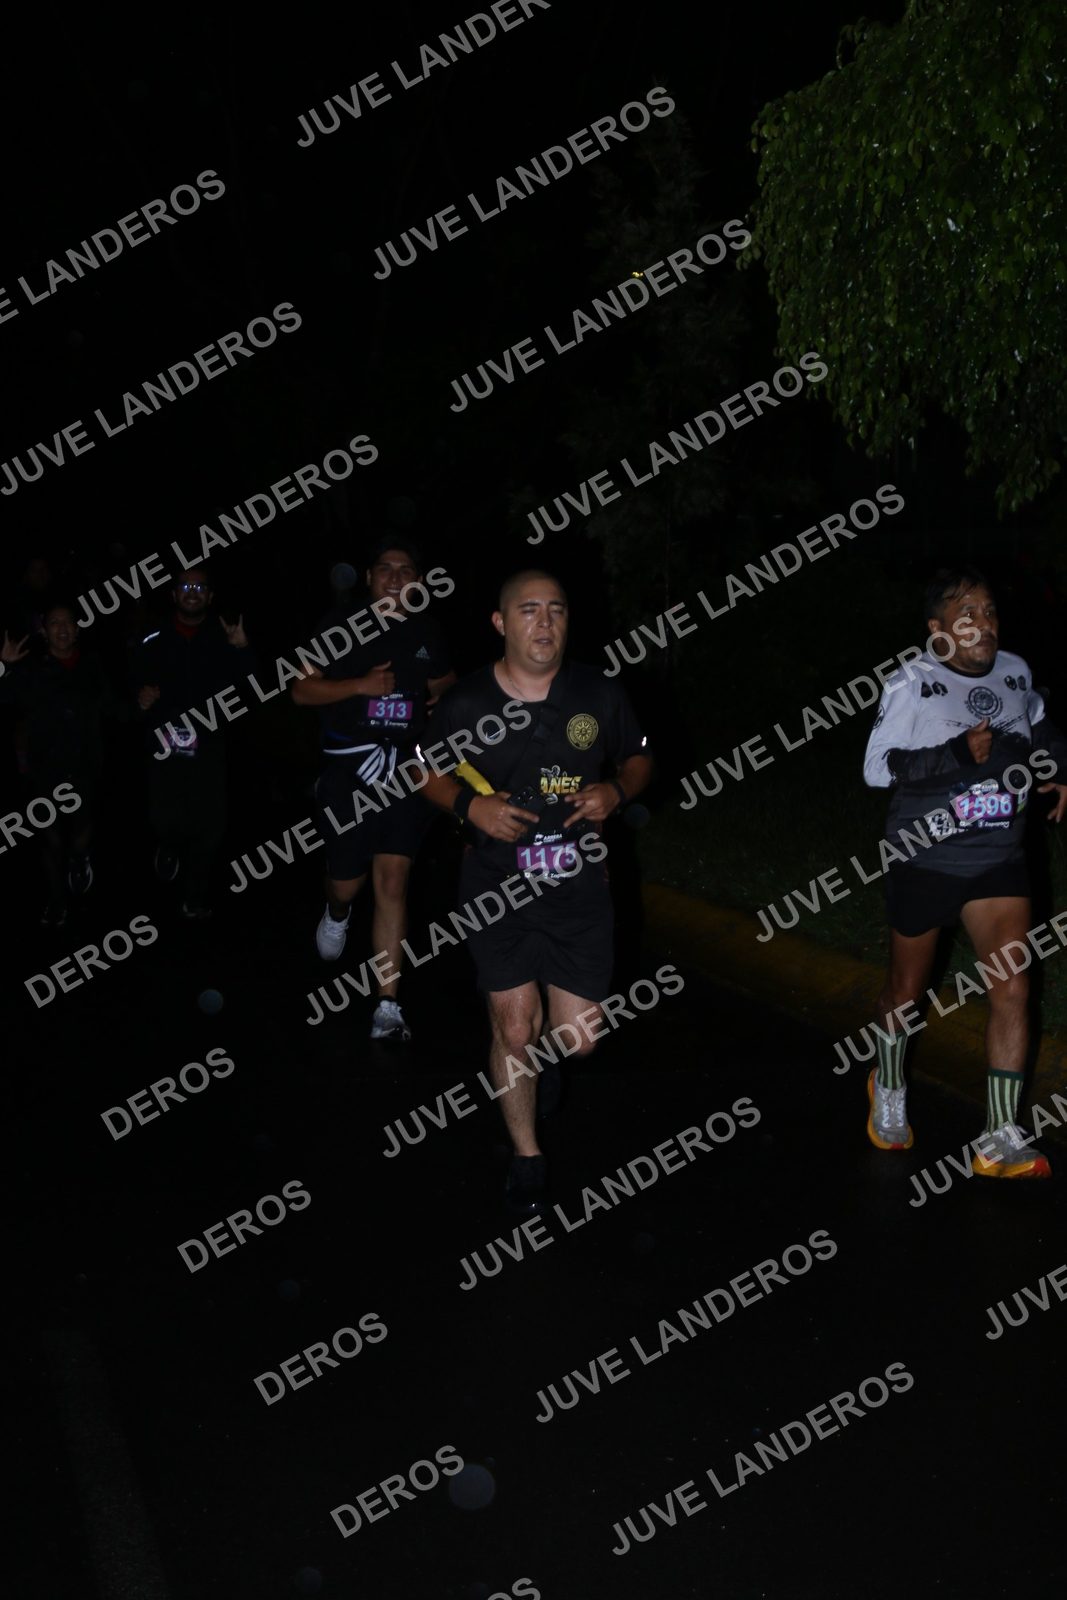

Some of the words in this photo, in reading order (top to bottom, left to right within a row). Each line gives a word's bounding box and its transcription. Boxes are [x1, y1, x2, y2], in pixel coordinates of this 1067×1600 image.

[375, 702, 407, 718] 313
[960, 793, 1012, 817] 1596
[520, 843, 576, 868] 1175
